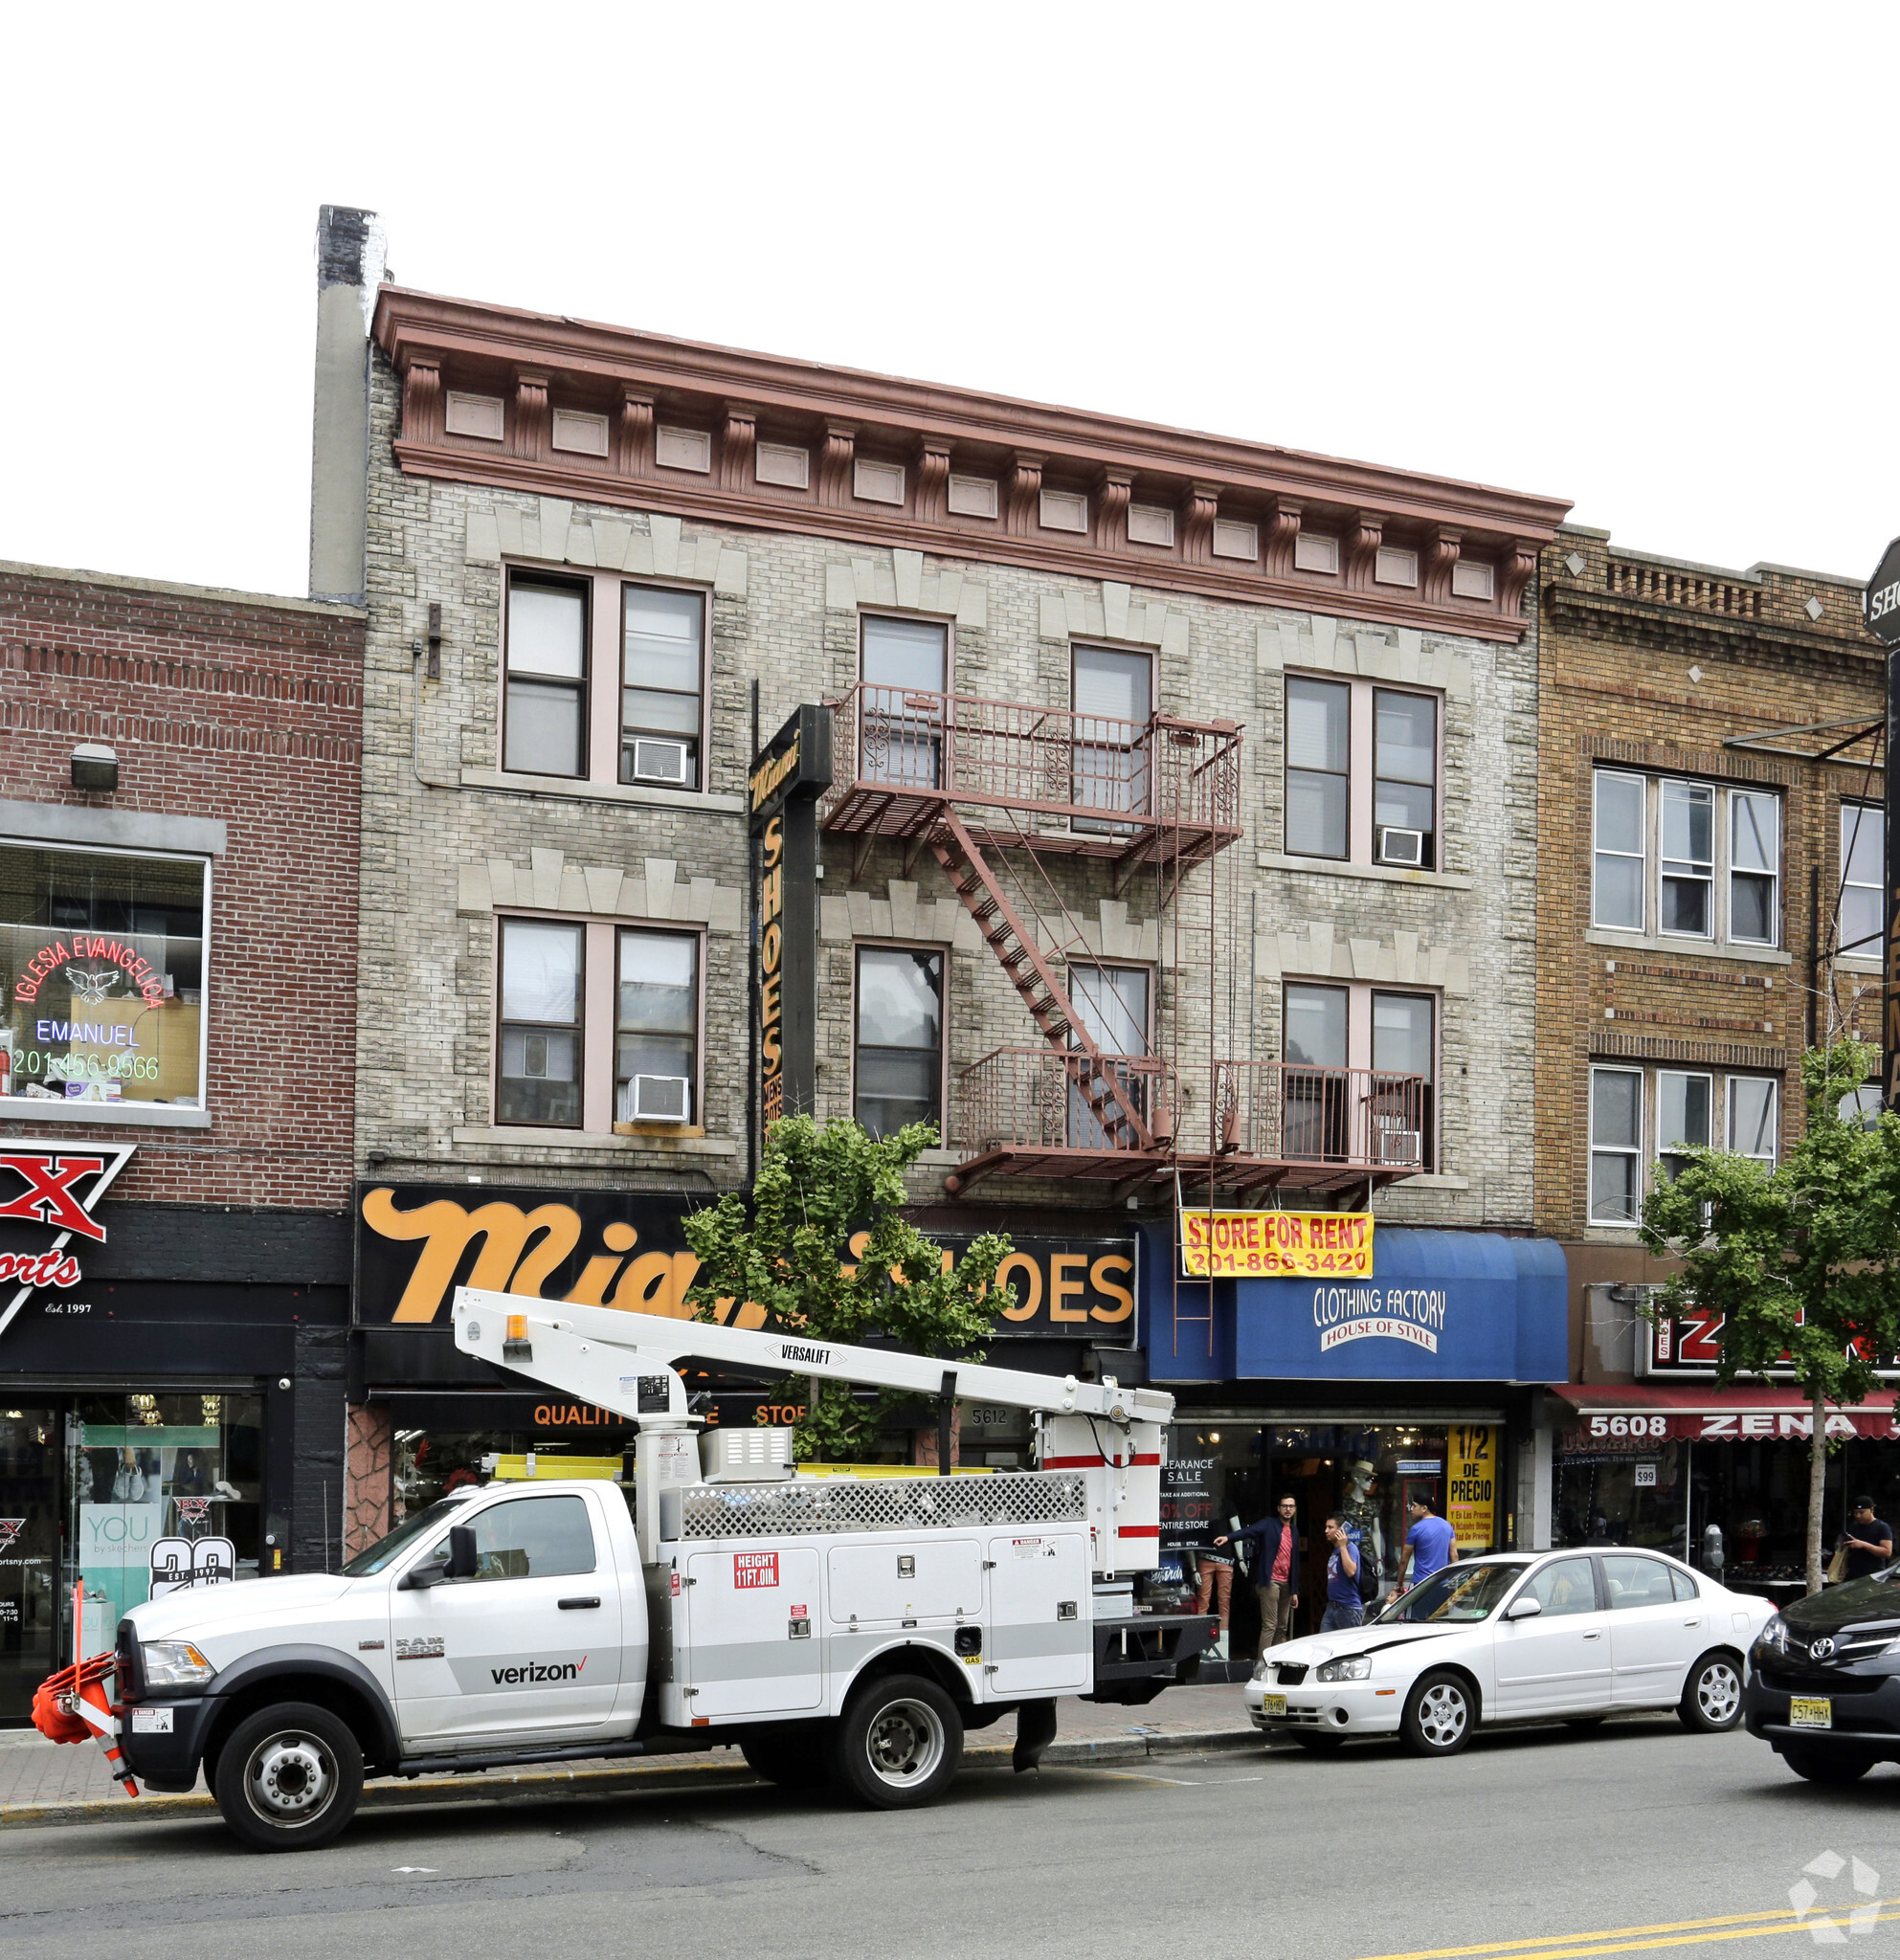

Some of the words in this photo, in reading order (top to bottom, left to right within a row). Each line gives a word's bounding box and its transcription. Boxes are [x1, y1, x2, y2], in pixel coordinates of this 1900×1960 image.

[1870, 580, 1900, 622] SH
[749, 728, 800, 812] Miami
[762, 816, 783, 1076] SHOES
[14, 942, 72, 1002] IGLESIA
[73, 936, 167, 1011] EVANGELICA
[36, 1019, 141, 1048] EMANUEL
[1189, 1217, 1260, 1250] STORE
[1265, 1216, 1303, 1249] FOR
[1310, 1218, 1367, 1249] RENT
[362, 1188, 876, 1330] Mia
[888, 1250, 1133, 1324] OES
[1192, 1252, 1366, 1273] 201-866-3420
[67, 1303, 92, 1313] 1997
[1313, 1287, 1382, 1327] CLOTHING
[1387, 1289, 1445, 1330] FACTORY
[1327, 1321, 1372, 1346] HOUSE
[1376, 1321, 1393, 1334] OF
[1397, 1324, 1432, 1348] STYLE
[1659, 1306, 1669, 1356] HOES
[781, 1344, 831, 1365] VERSALIFT
[972, 1409, 1007, 1424] 5612
[1590, 1416, 1666, 1437] 5608
[1700, 1414, 1857, 1435] ZENA
[1457, 1425, 1488, 1459] 1/2
[1160, 1459, 1214, 1470] EARANCE
[1464, 1463, 1480, 1478] DE
[1168, 1471, 1201, 1481] SALE
[1638, 1472, 1654, 1482] $99
[1451, 1481, 1492, 1502] PRECIO
[178, 1498, 210, 1511] BX
[1159, 1503, 1182, 1519] 0%
[1185, 1503, 1214, 1519] OFF
[87, 1516, 148, 1542] YOU
[1159, 1522, 1184, 1530] ENTIRE
[1185, 1521, 1209, 1529] STORE
[94, 1544, 104, 1555] by
[107, 1544, 147, 1553] skechers
[737, 1554, 775, 1569] HEIGHT
[168, 1572, 189, 1581] EST.
[194, 1569, 216, 1577] 1997
[395, 1636, 445, 1647] RAM
[395, 1645, 445, 1655] 4500
[490, 1661, 576, 1684] verizon
